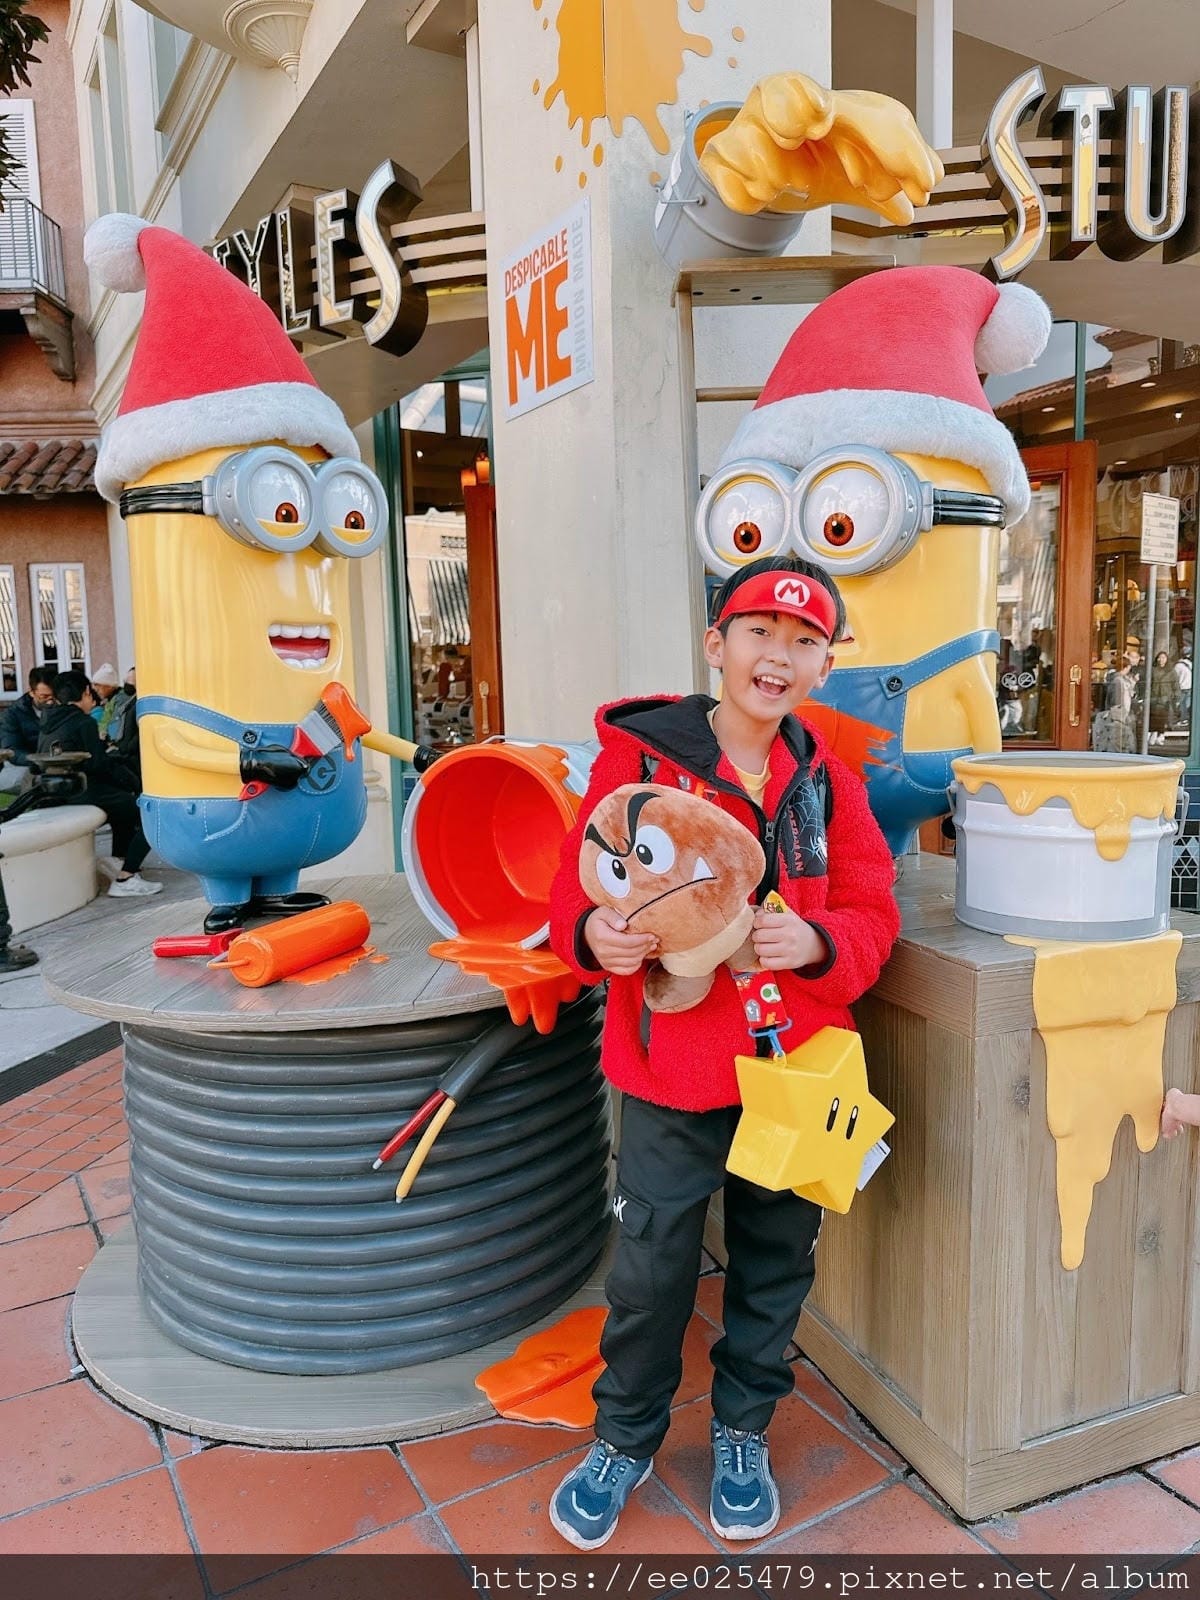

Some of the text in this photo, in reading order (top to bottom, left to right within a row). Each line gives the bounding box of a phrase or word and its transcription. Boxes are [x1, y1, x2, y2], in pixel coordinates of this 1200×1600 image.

[988, 65, 1191, 280] STU
[212, 157, 401, 347] YLES
[504, 228, 568, 298] DESPICABLE
[571, 215, 586, 374] MINION MADE
[505, 259, 572, 406] ME
[777, 581, 805, 604] M
